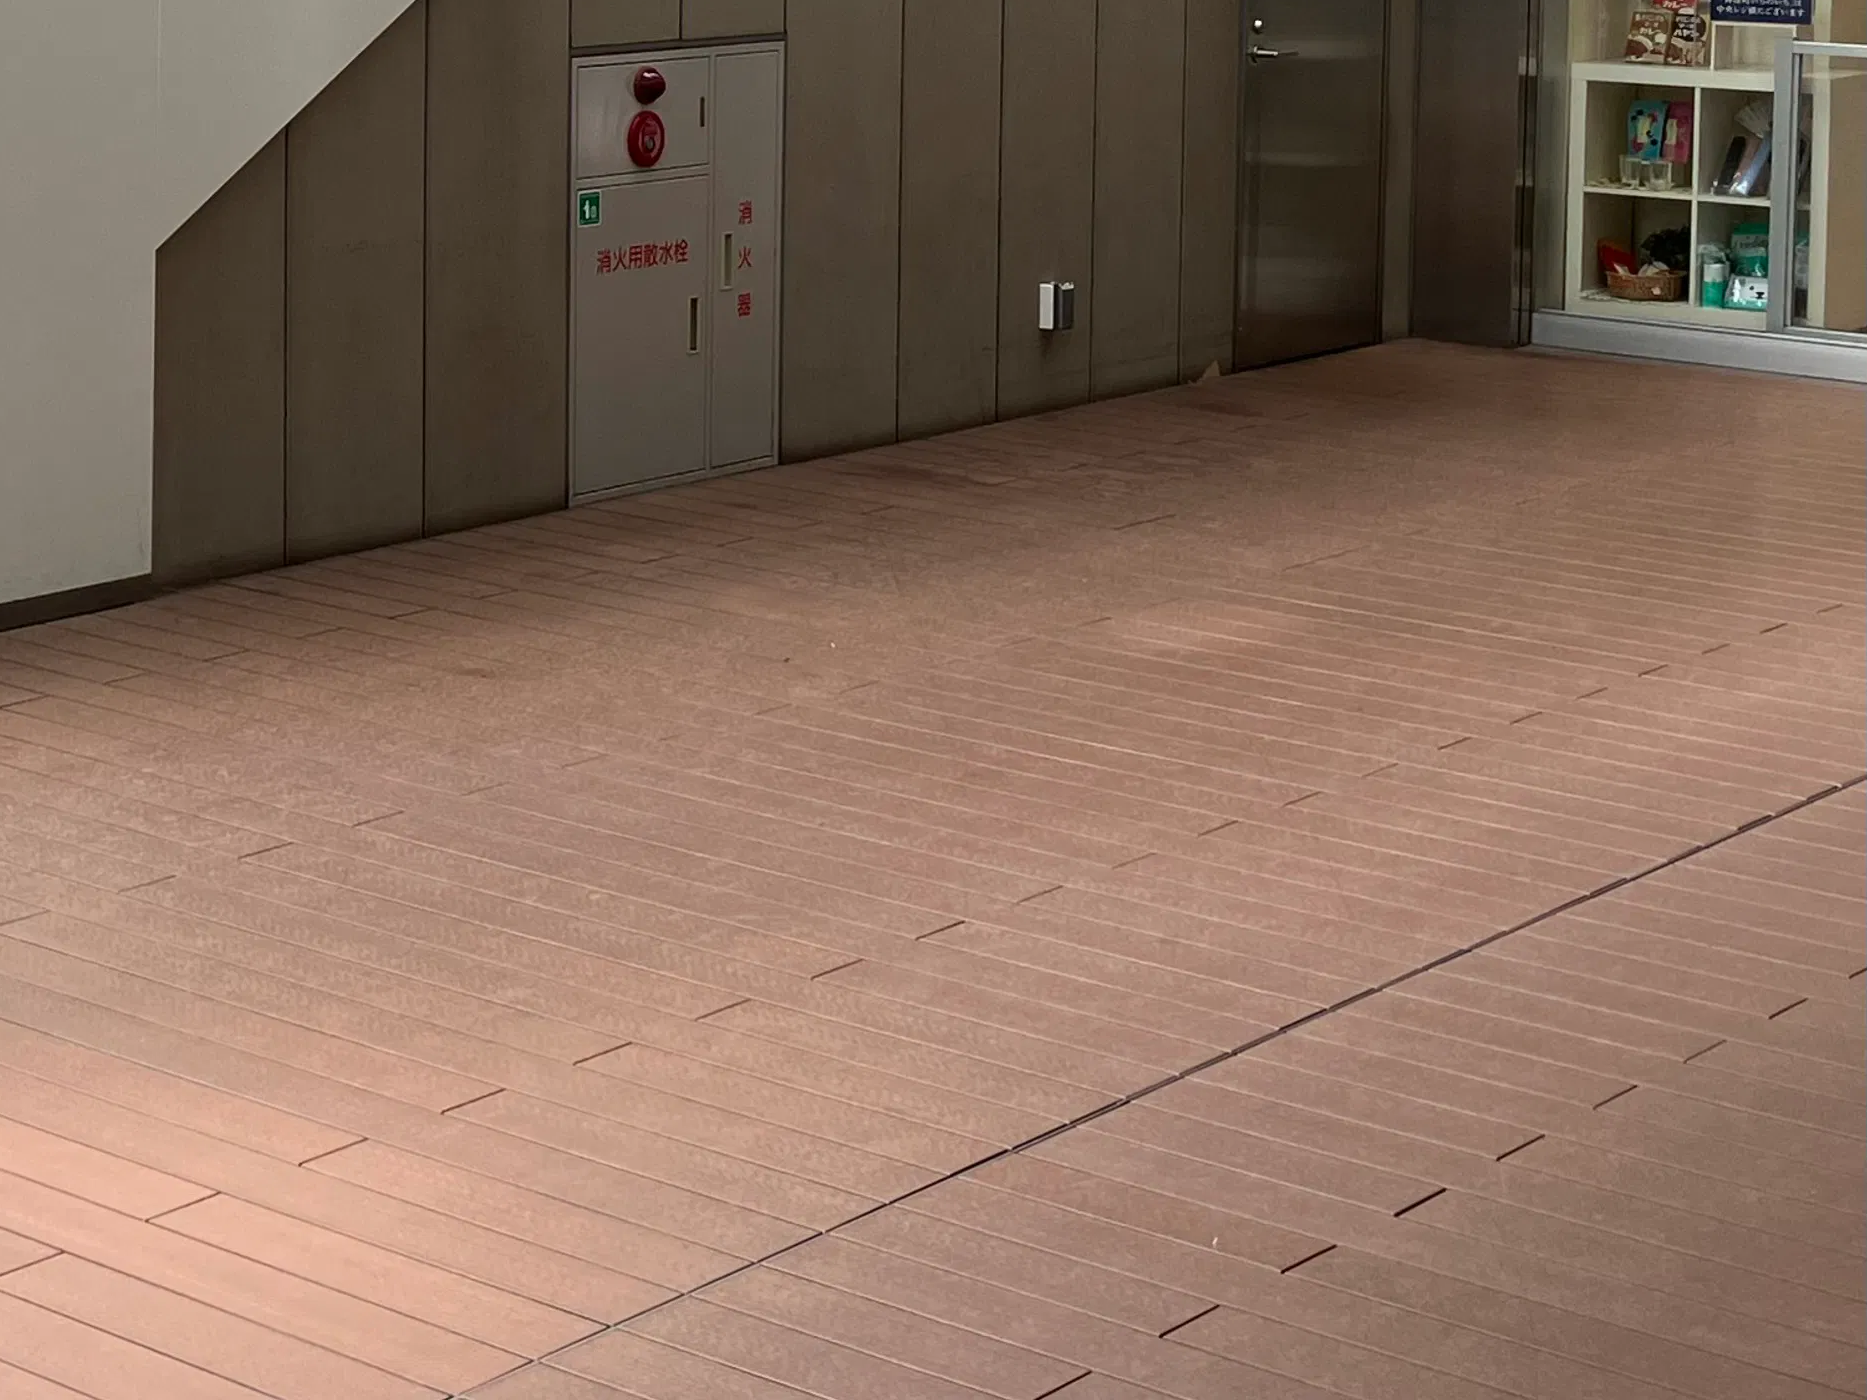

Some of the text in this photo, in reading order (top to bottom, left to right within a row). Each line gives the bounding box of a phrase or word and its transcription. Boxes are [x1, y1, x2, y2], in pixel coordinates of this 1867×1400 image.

[595, 239, 689, 275] 消火用散水栓
